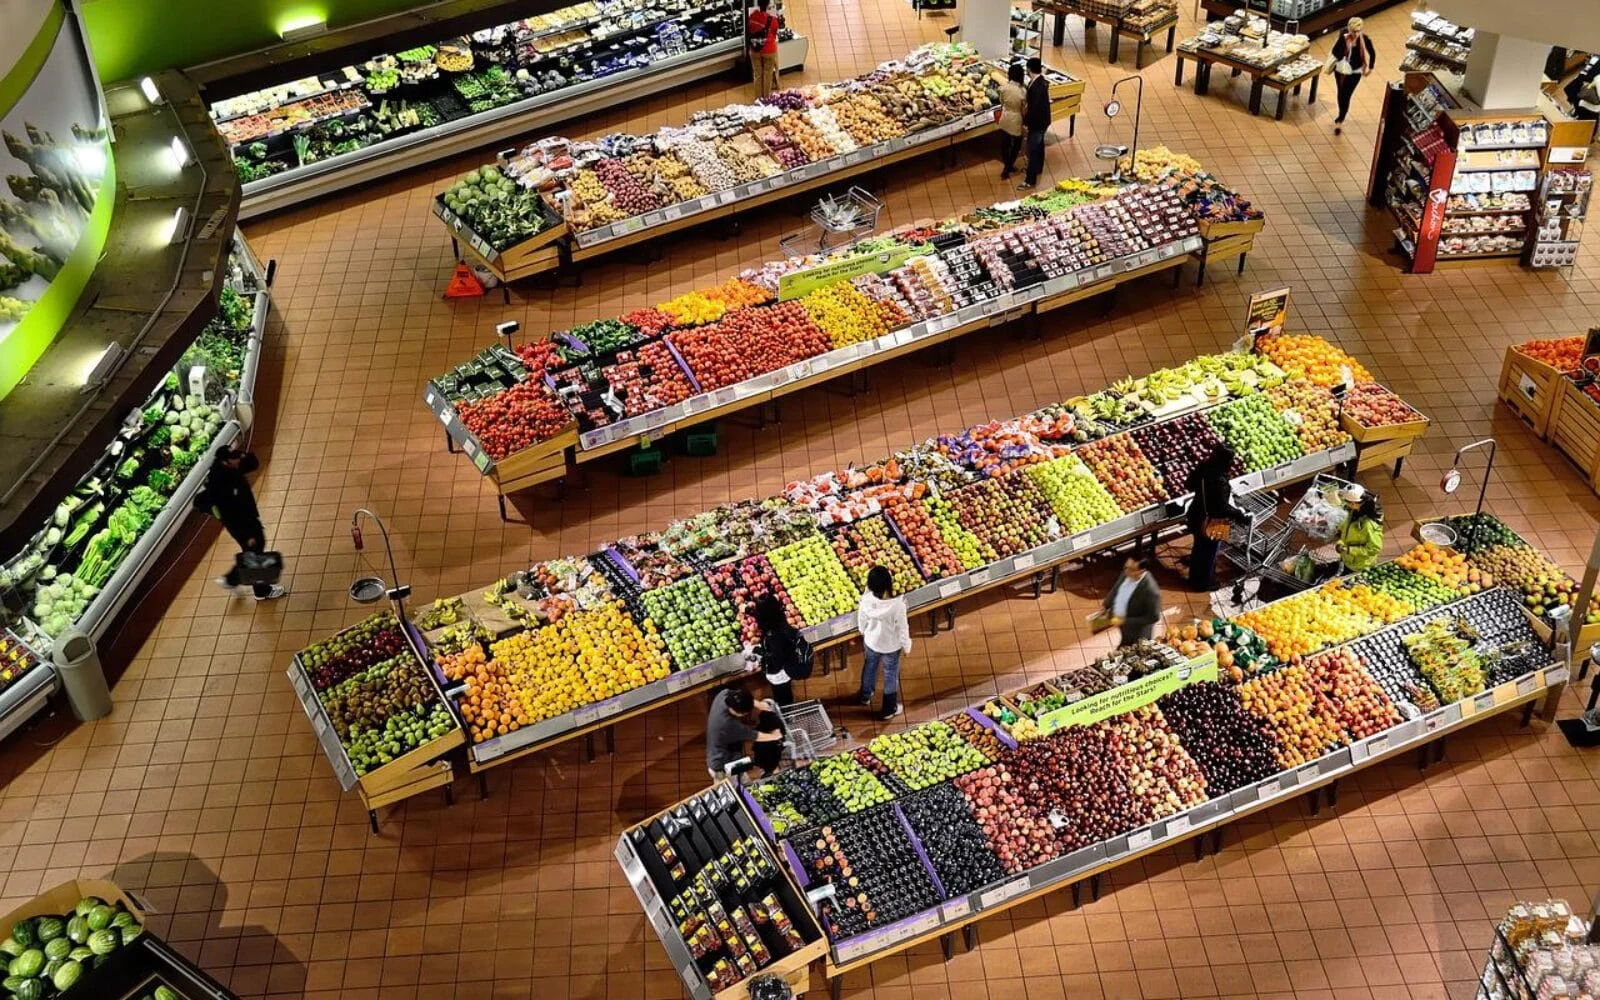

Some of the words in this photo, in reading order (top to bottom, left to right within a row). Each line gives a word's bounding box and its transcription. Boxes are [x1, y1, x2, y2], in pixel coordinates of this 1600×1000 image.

[1071, 701, 1098, 715] Looking
[1099, 696, 1109, 704] for
[1110, 685, 1144, 700] nutritious
[1144, 671, 1173, 687] choices?
[1090, 703, 1111, 715] Reach
[1123, 694, 1135, 702] the
[1136, 684, 1156, 697] Stars!
